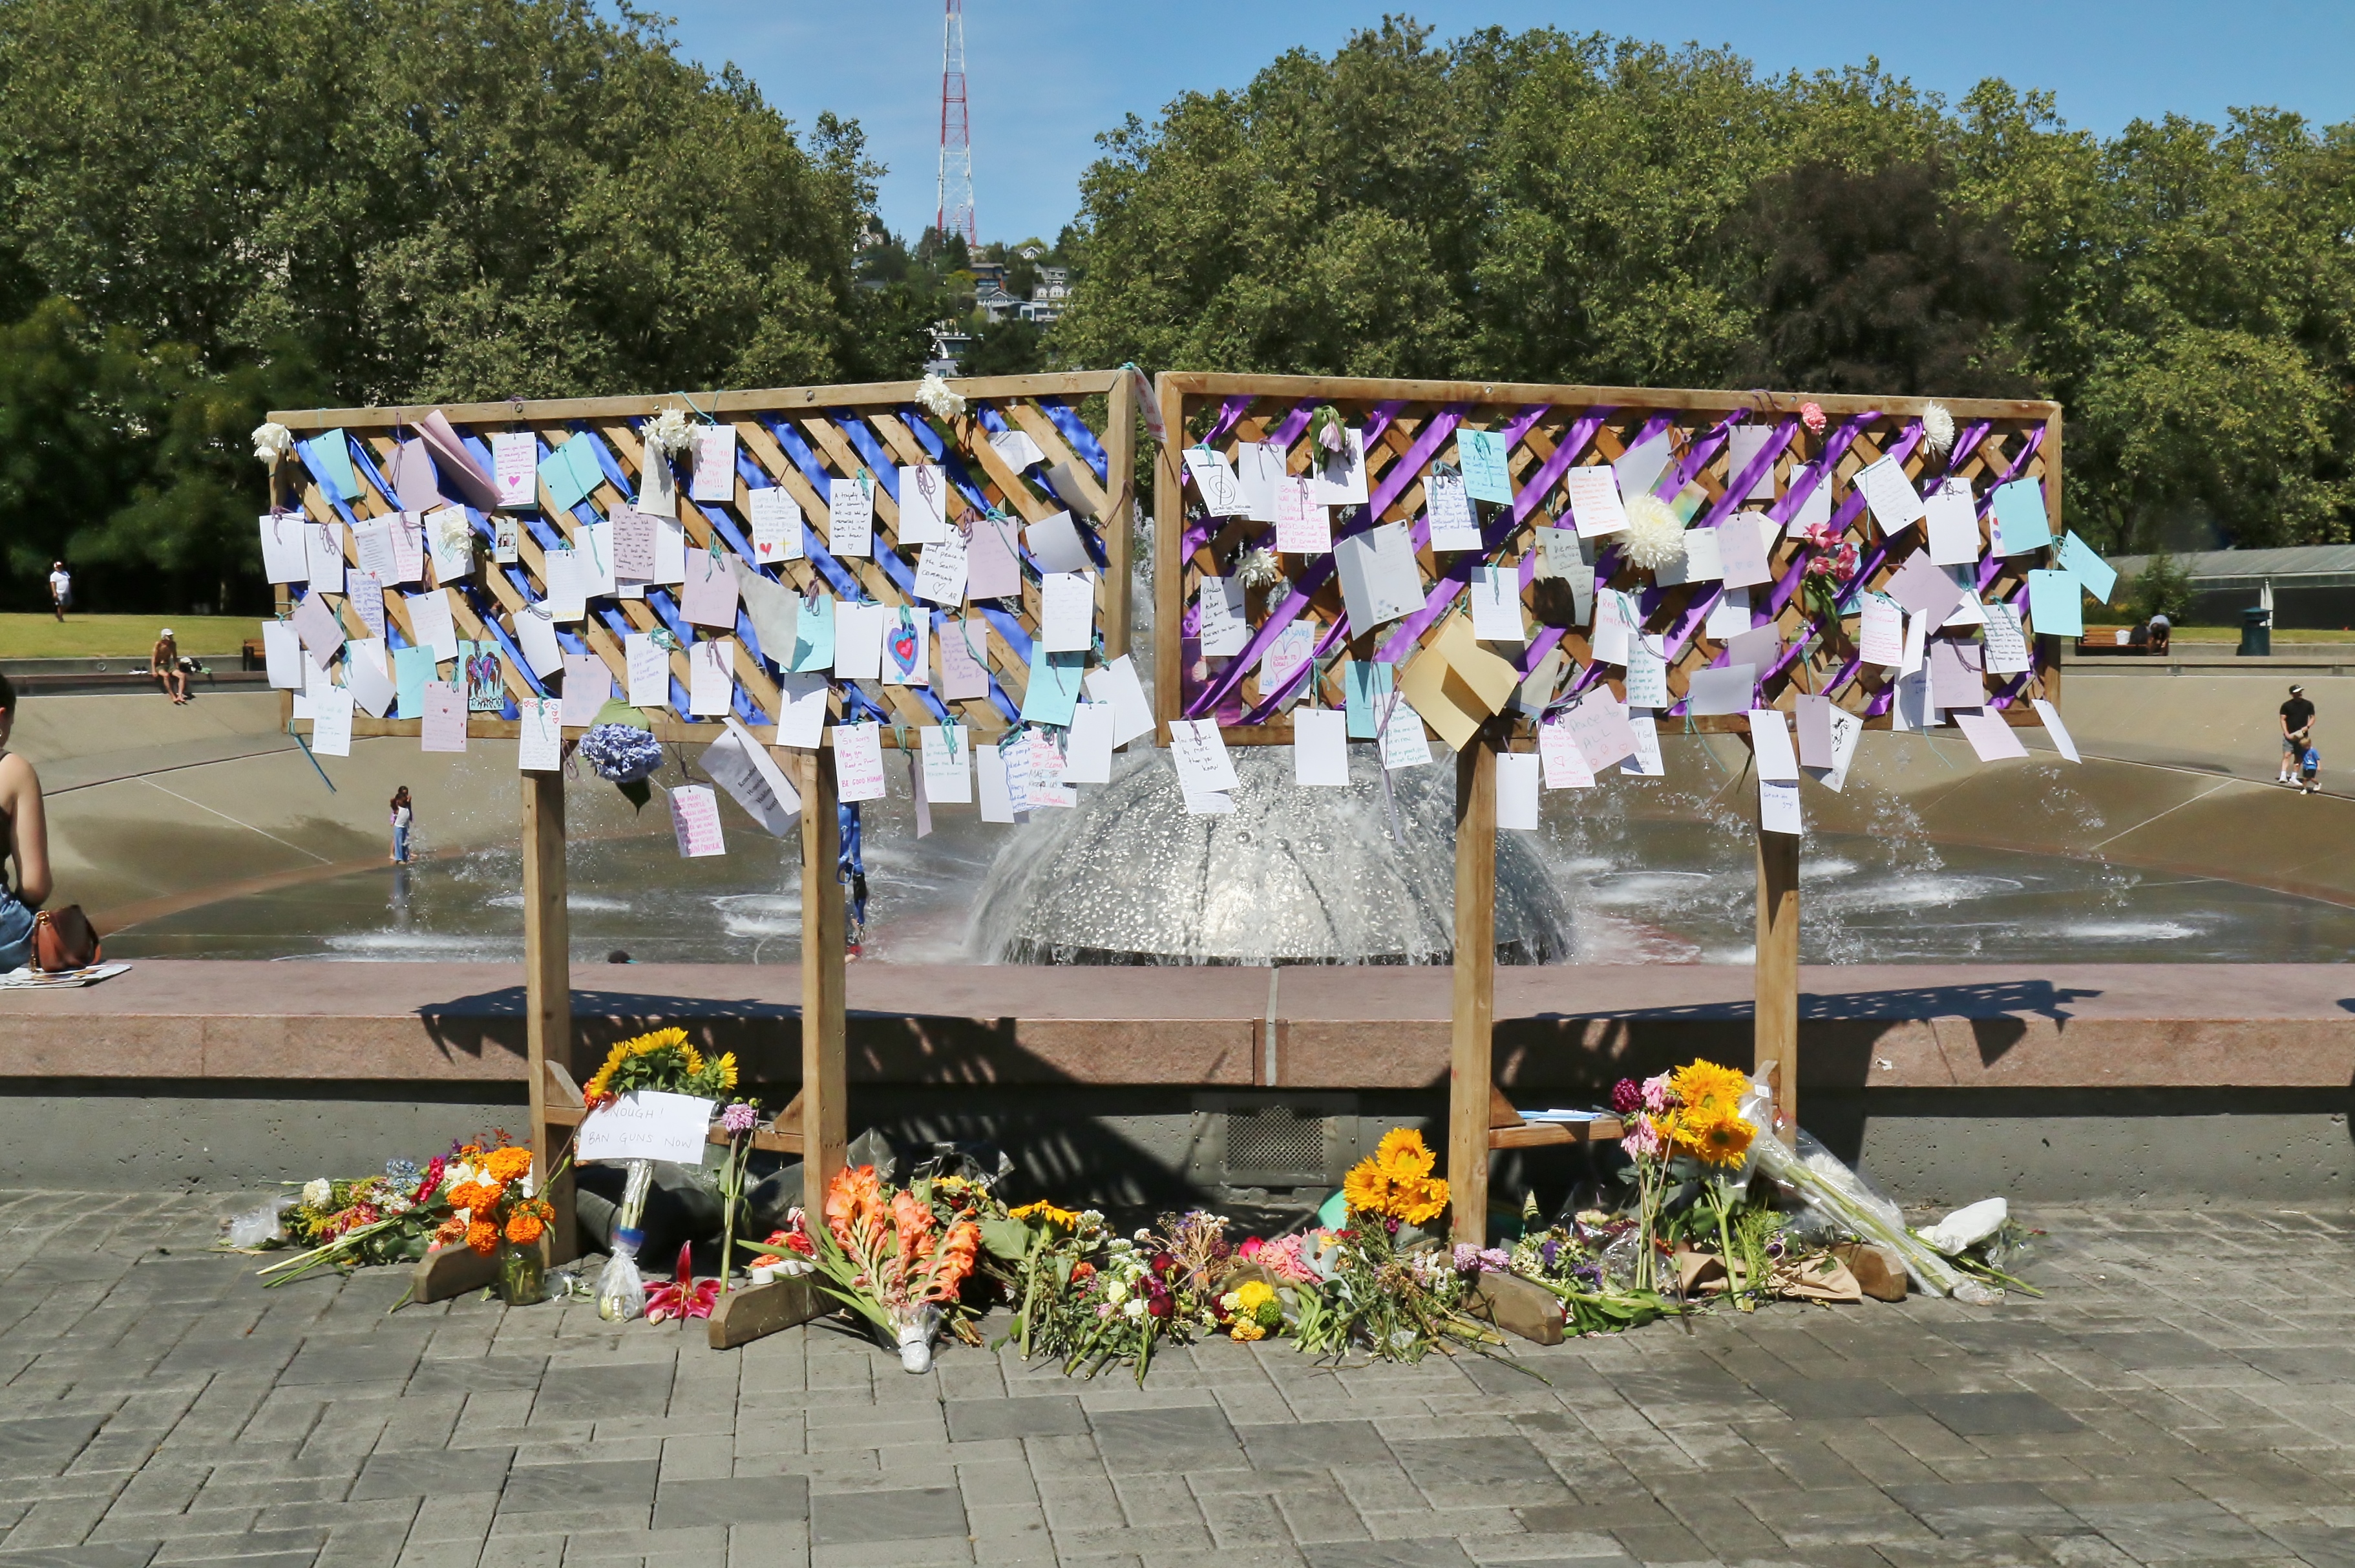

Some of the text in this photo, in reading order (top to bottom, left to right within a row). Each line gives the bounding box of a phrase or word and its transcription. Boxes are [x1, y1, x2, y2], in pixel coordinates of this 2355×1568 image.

[940, 562, 958, 571] Seattle
[1603, 599, 1617, 609] Rest
[1570, 705, 1619, 732] Peace to
[1178, 734, 1187, 745] You
[1583, 729, 1610, 749] ALL
[840, 750, 852, 760] May
[1183, 747, 1190, 756] by
[867, 774, 883, 783] HUMANS
[687, 845, 701, 854] GUN
[589, 1131, 693, 1149] BAN GUNS NOW
